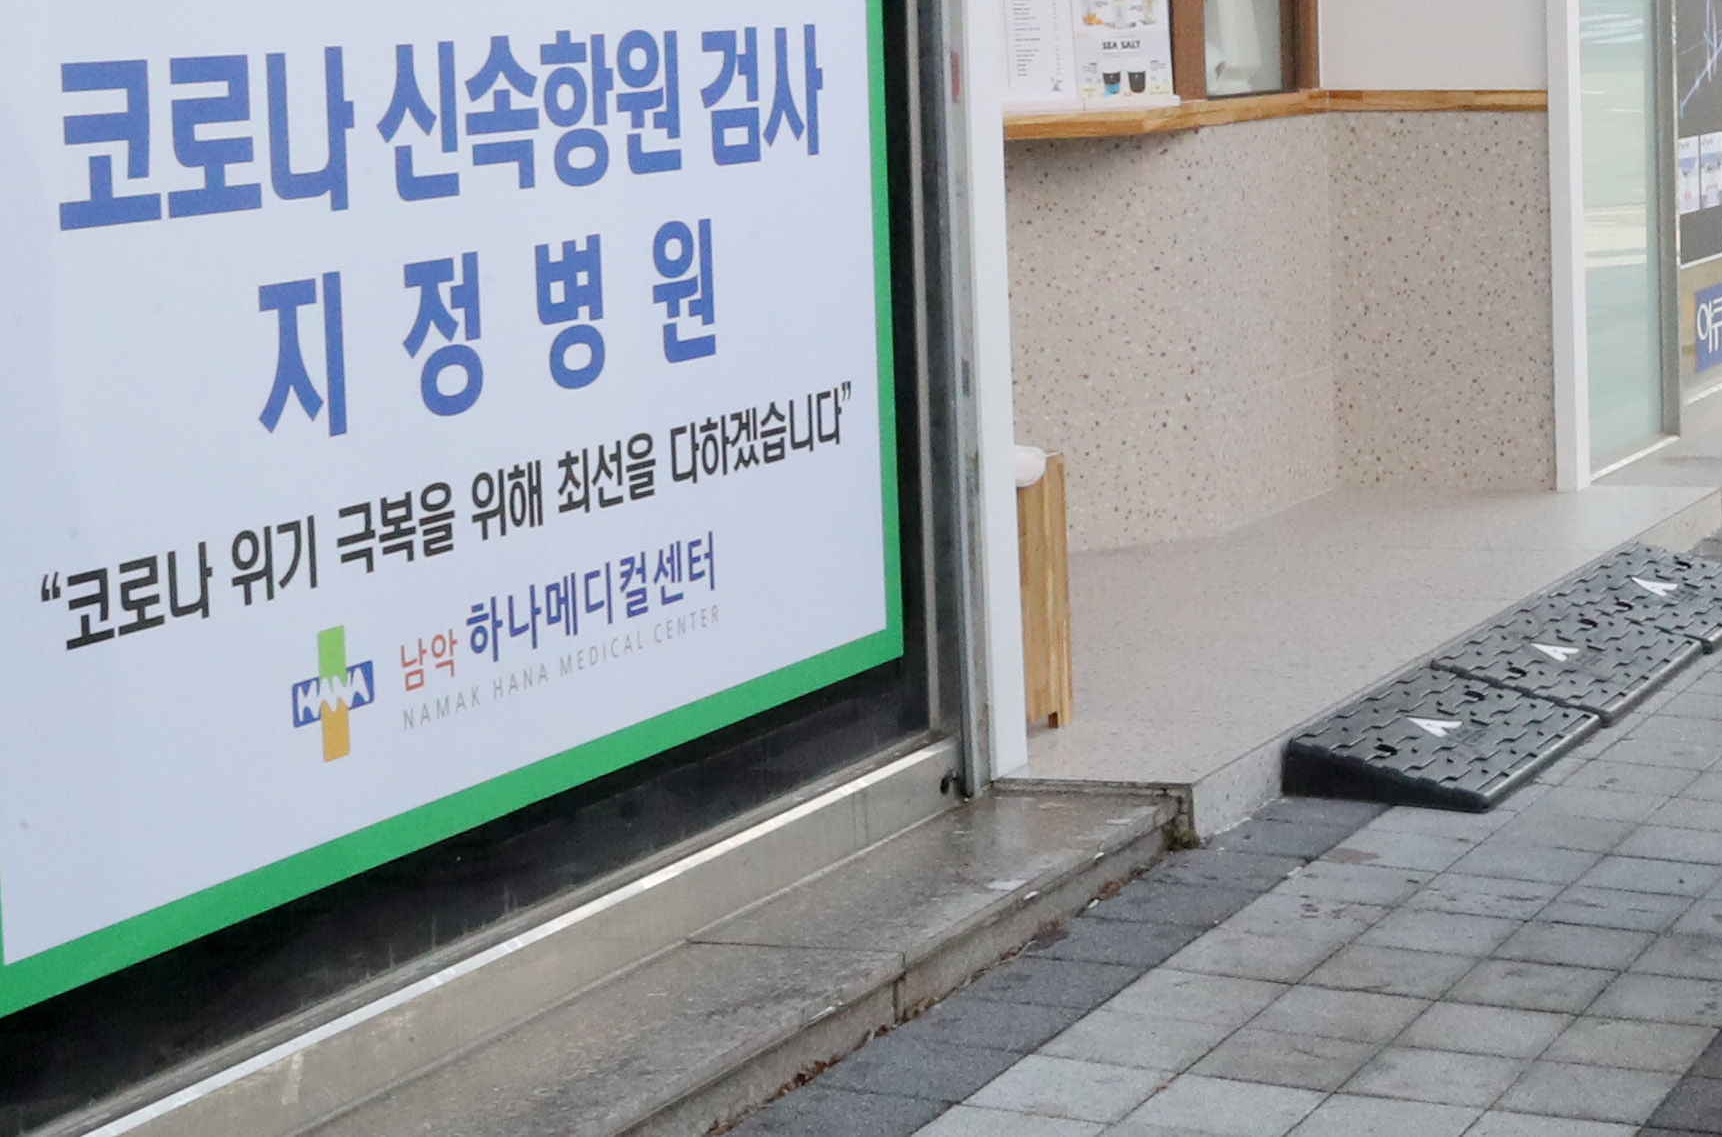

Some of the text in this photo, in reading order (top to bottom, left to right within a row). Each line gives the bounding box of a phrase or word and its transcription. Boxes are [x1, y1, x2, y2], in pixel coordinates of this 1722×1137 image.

[59, 46, 355, 231] 코로나
[376, 29, 682, 202] 신속항원
[700, 24, 823, 166] 검사
[1103, 40, 1141, 50] SEA SALT
[258, 218, 722, 440] 지정병원
[231, 515, 318, 606] 위기
[336, 482, 456, 574] 극복을
[471, 459, 544, 541] 위해
[557, 432, 657, 514] 최선을
[401, 528, 715, 691] 남악 하나메디컬센터
[404, 601, 718, 729] NAMAK HANA MEDICAL CENTER
